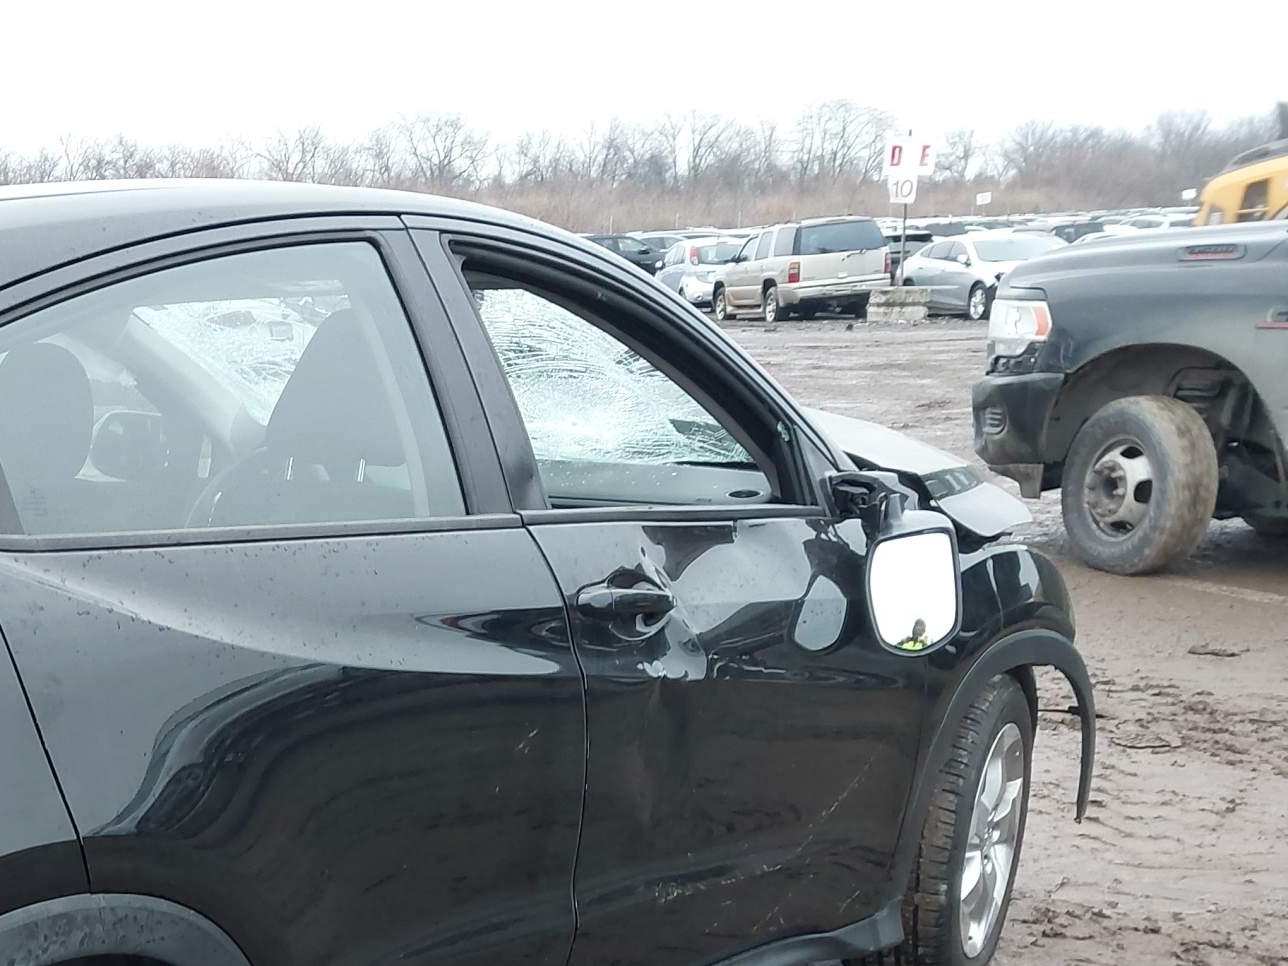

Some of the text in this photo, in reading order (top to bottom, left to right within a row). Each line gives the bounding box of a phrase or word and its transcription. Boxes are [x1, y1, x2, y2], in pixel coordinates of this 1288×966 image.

[890, 145, 903, 166] D
[920, 145, 931, 166] E
[892, 179, 914, 198] 10
